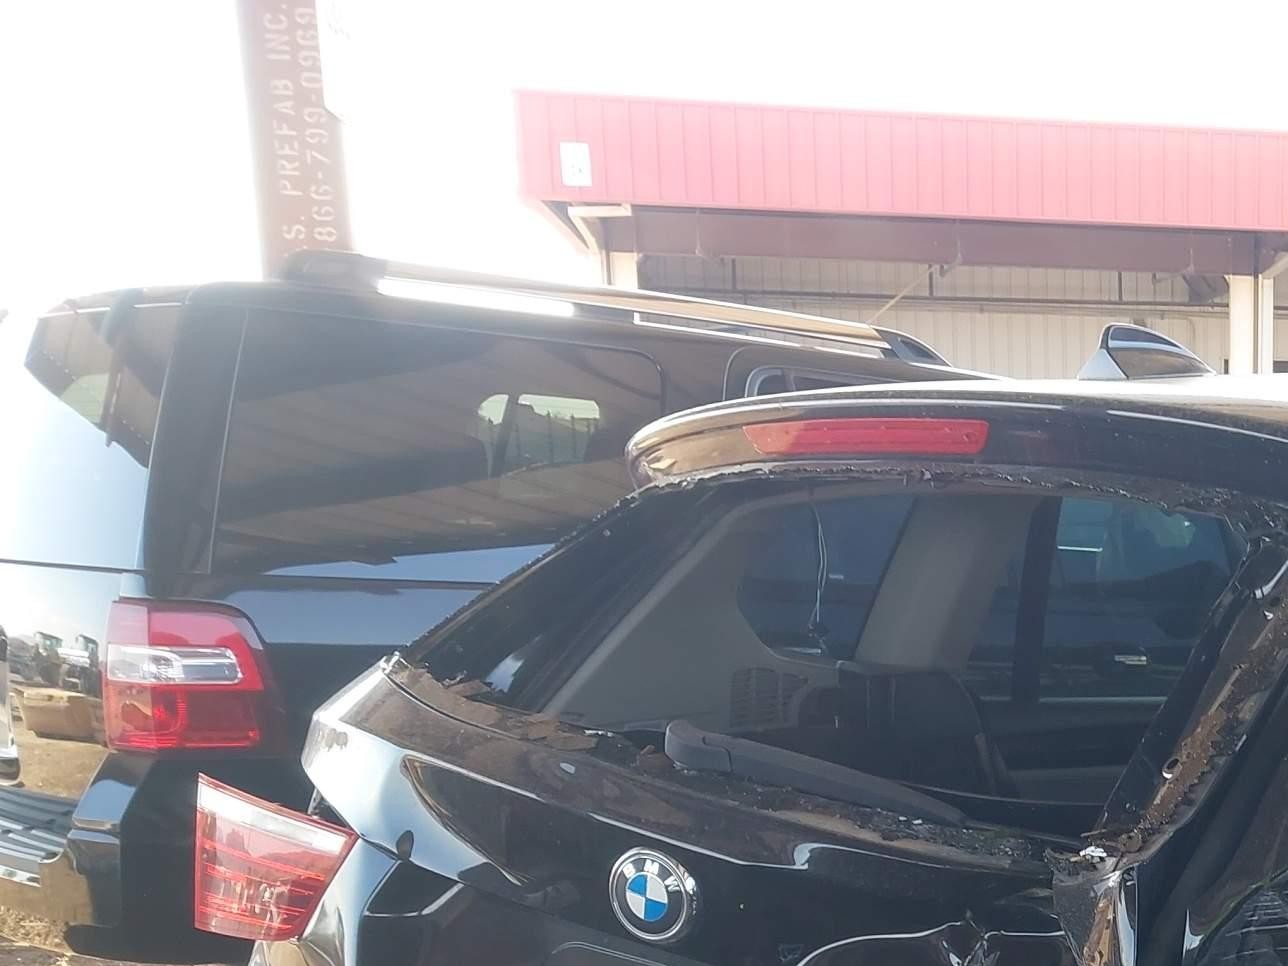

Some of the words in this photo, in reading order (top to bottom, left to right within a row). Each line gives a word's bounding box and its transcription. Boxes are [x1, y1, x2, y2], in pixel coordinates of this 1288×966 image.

[263, 3, 291, 60] INC.
[270, 79, 303, 196] PREFAB
[281, 216, 306, 257] .S.
[622, 858, 681, 893] BMW
